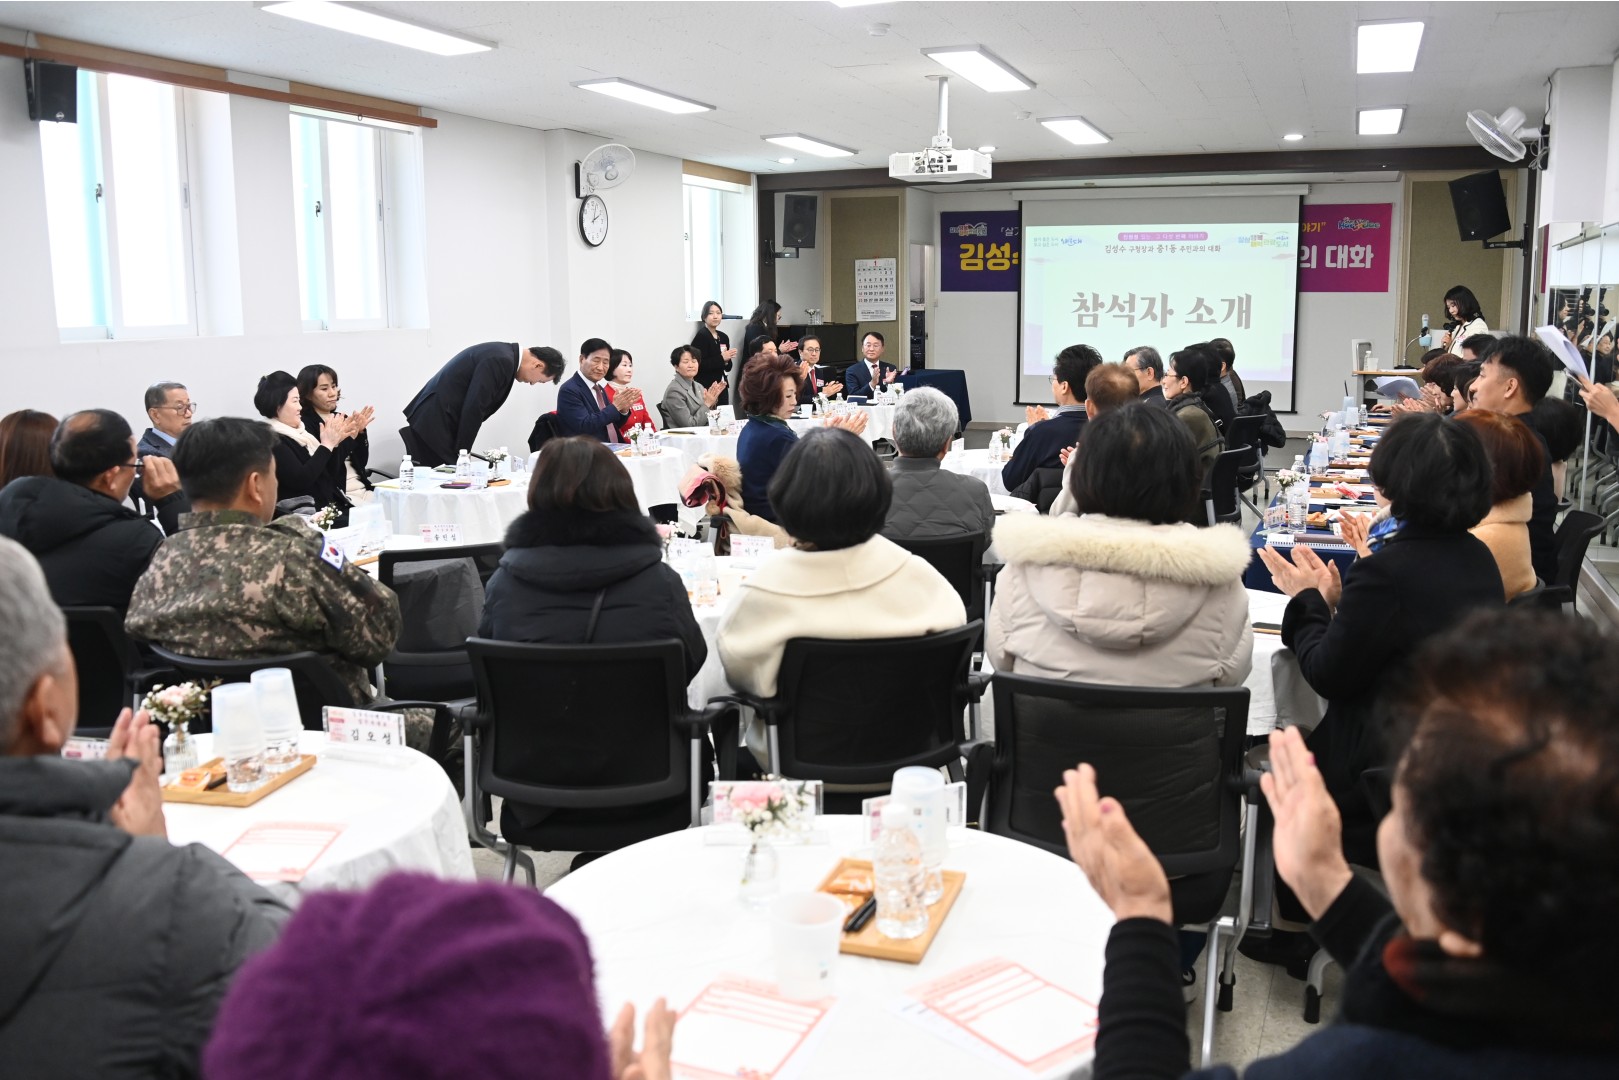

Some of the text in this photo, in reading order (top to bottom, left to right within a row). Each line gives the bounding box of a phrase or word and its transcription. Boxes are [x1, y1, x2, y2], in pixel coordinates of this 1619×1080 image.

[1104, 244, 1126, 253] 김성수
[1129, 244, 1154, 253] 구청장과
[1179, 244, 1205, 253] 주민과의
[1208, 244, 1221, 252] 대화
[1325, 244, 1374, 268] 대화
[1071, 292, 1252, 330] 참석자 소개
